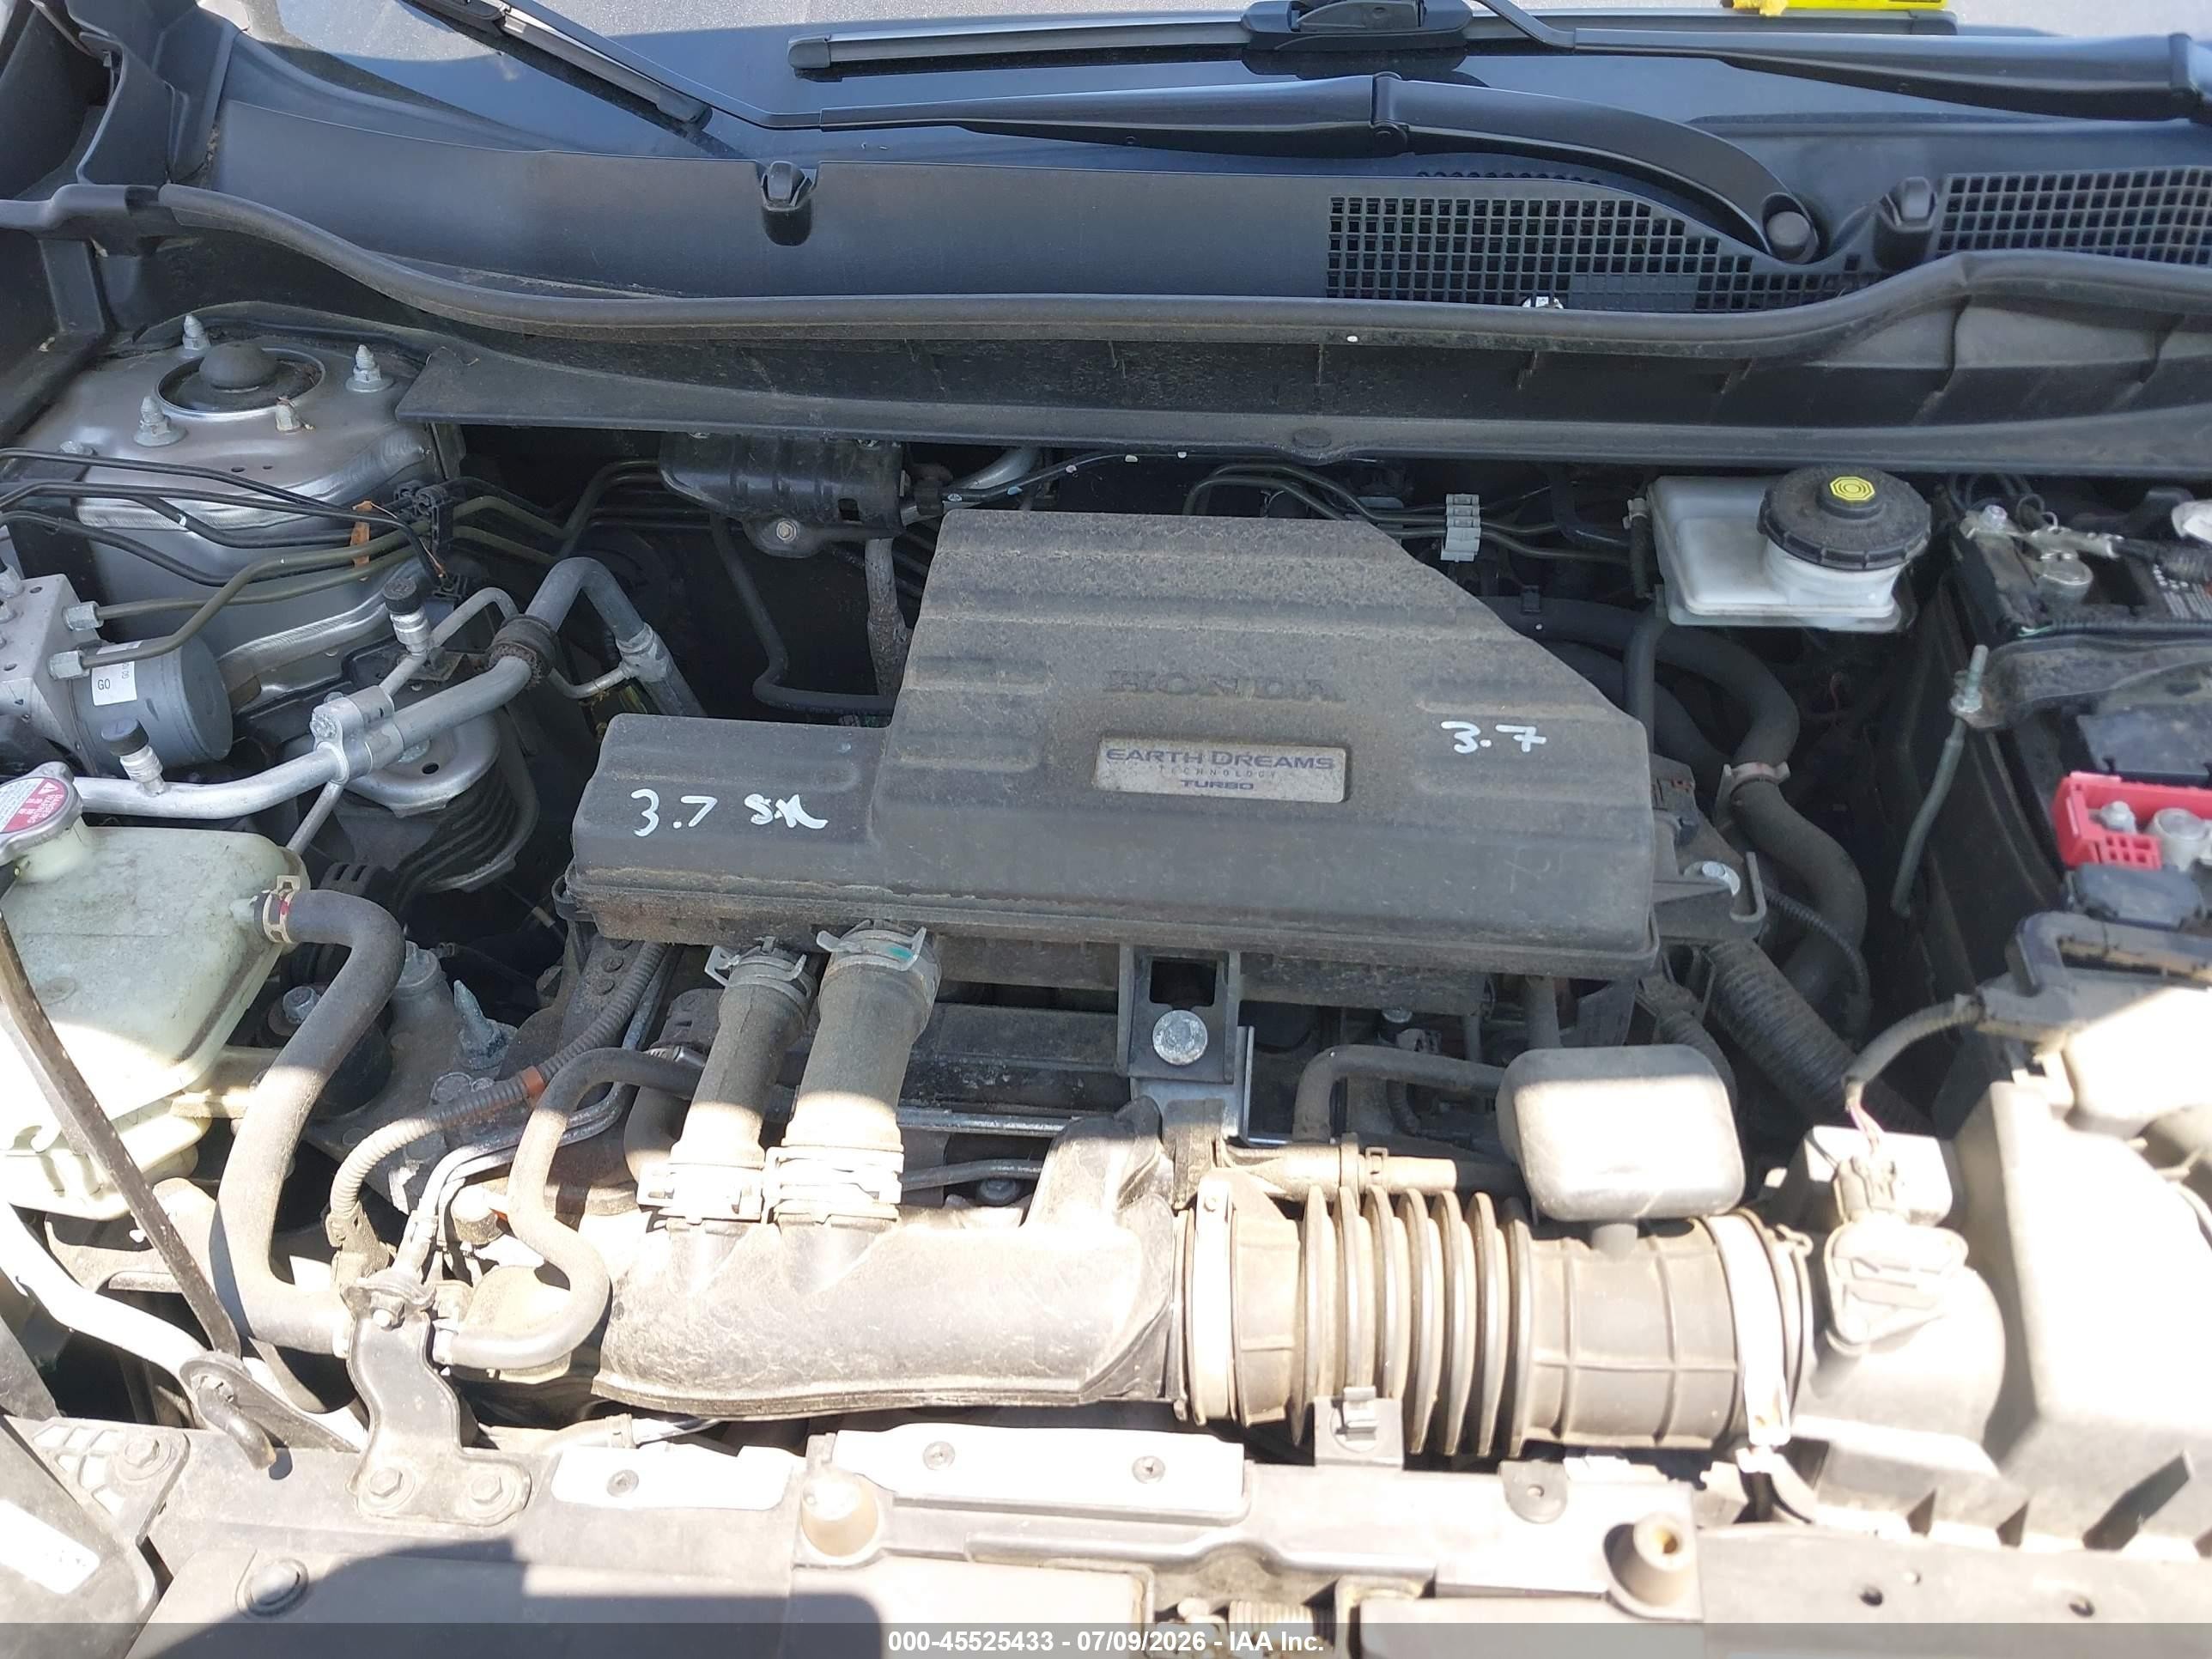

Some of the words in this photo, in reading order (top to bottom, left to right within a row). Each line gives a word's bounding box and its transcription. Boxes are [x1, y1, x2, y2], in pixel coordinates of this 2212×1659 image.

[1103, 670, 1346, 702] HONDA
[1440, 720, 1547, 753] 3.7
[1106, 748, 1204, 765] EARTH
[1212, 750, 1334, 769] DREAMS
[1159, 764, 1277, 779] TECHNOLOGY
[1180, 779, 1255, 790] TURBO
[630, 788, 718, 837] 3.7
